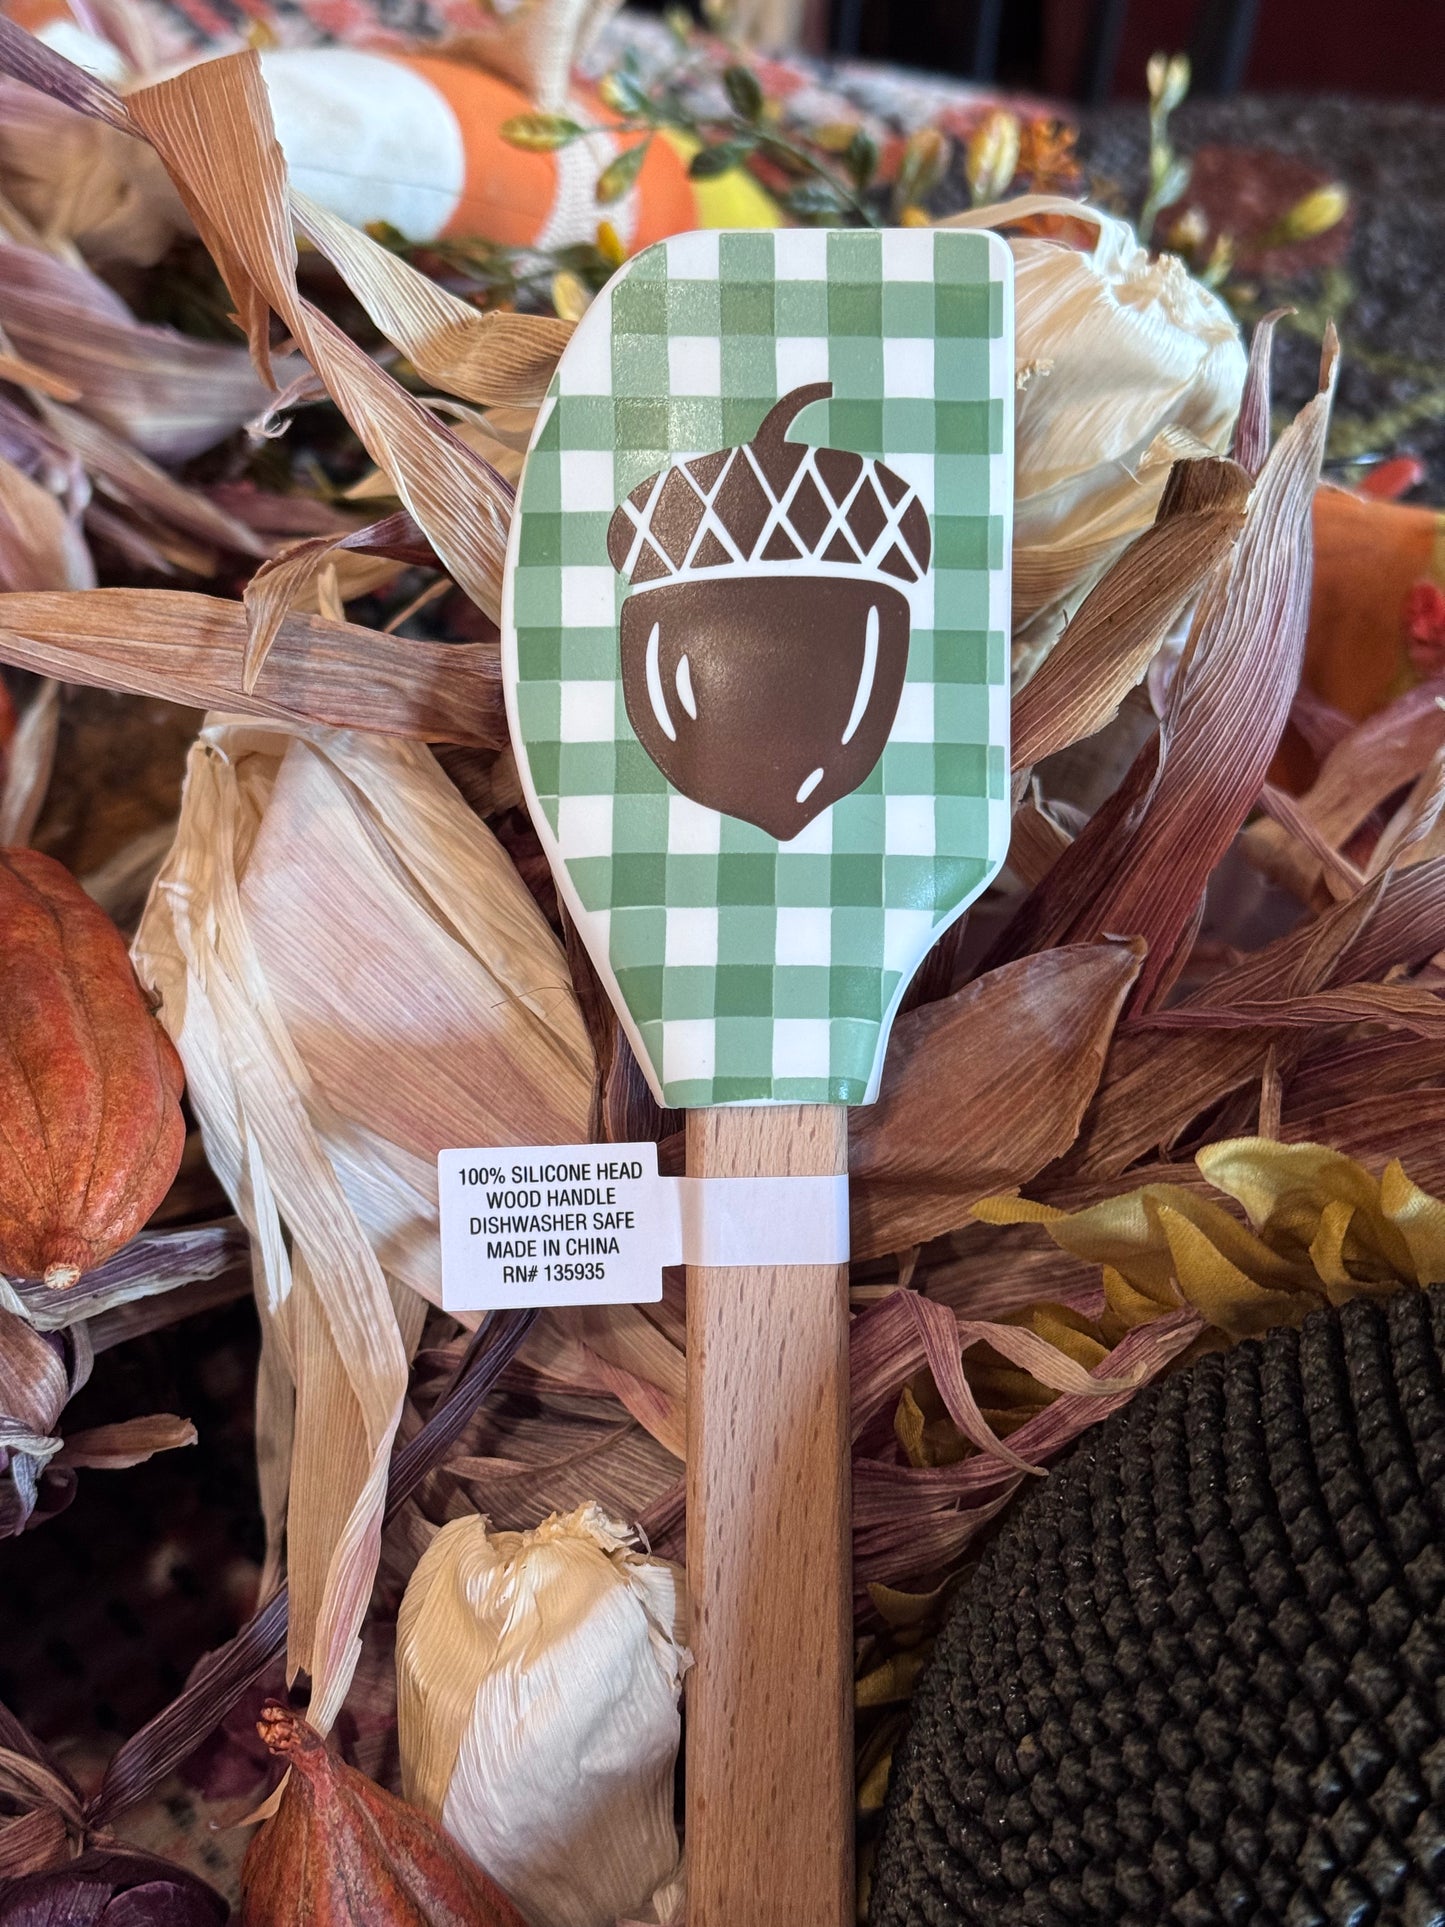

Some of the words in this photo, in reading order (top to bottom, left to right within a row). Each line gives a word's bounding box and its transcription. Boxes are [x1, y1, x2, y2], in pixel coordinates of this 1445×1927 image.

[459, 1167, 506, 1186] 100%
[511, 1164, 591, 1184] SILICONE
[597, 1161, 643, 1180] HEAD
[486, 1190, 541, 1209] WOOD
[547, 1188, 616, 1207] HANDLE
[470, 1213, 587, 1235] DISHWASHER
[593, 1211, 635, 1230] SAFE
[487, 1240, 537, 1259] MADE
[544, 1239, 560, 1256] IN
[566, 1237, 620, 1256] CHINA
[503, 1265, 538, 1283] RN#
[544, 1263, 605, 1282] 135935
